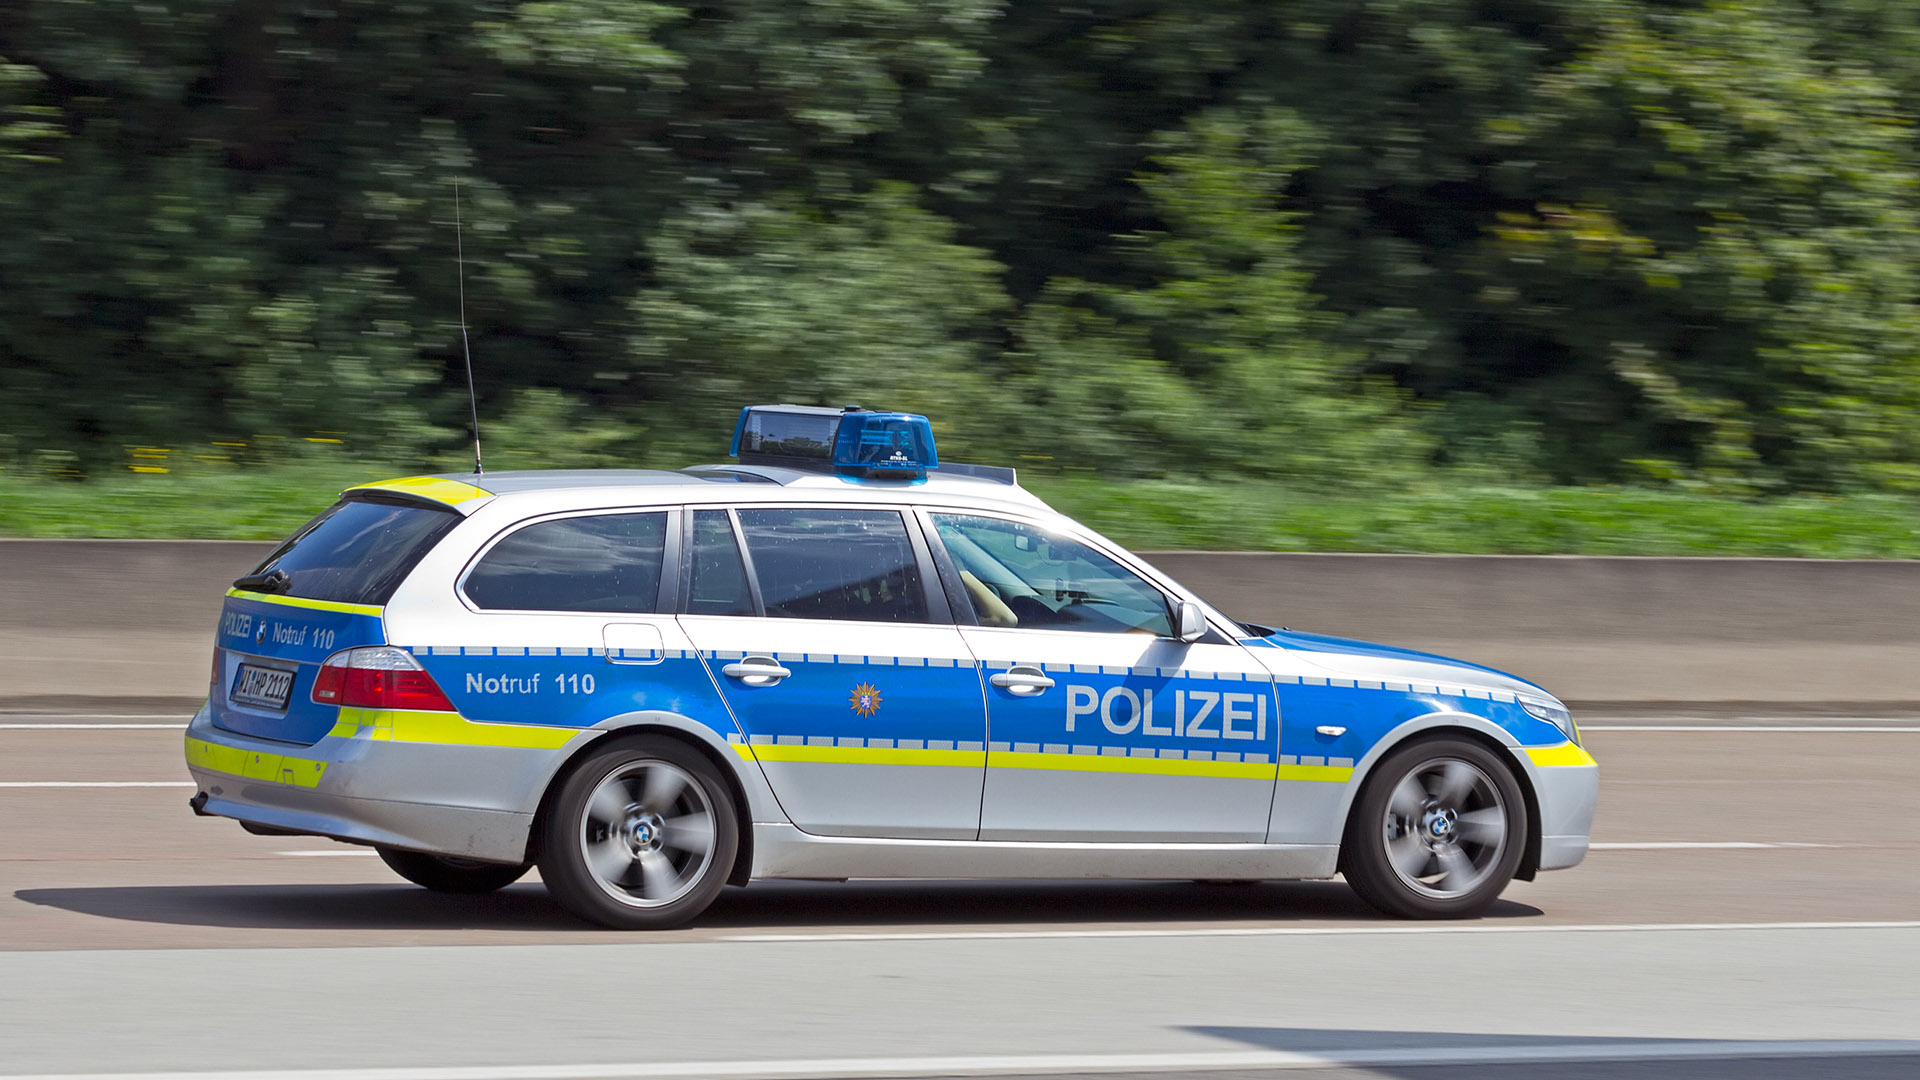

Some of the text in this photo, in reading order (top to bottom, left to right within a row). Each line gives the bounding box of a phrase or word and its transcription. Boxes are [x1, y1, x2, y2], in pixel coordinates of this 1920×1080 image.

[224, 612, 252, 638] POLIZEI
[272, 622, 335, 650] Notruf 110
[264, 673, 290, 700] 2112
[466, 673, 595, 694] Notruf 110
[1065, 684, 1267, 740] POLIZEI
